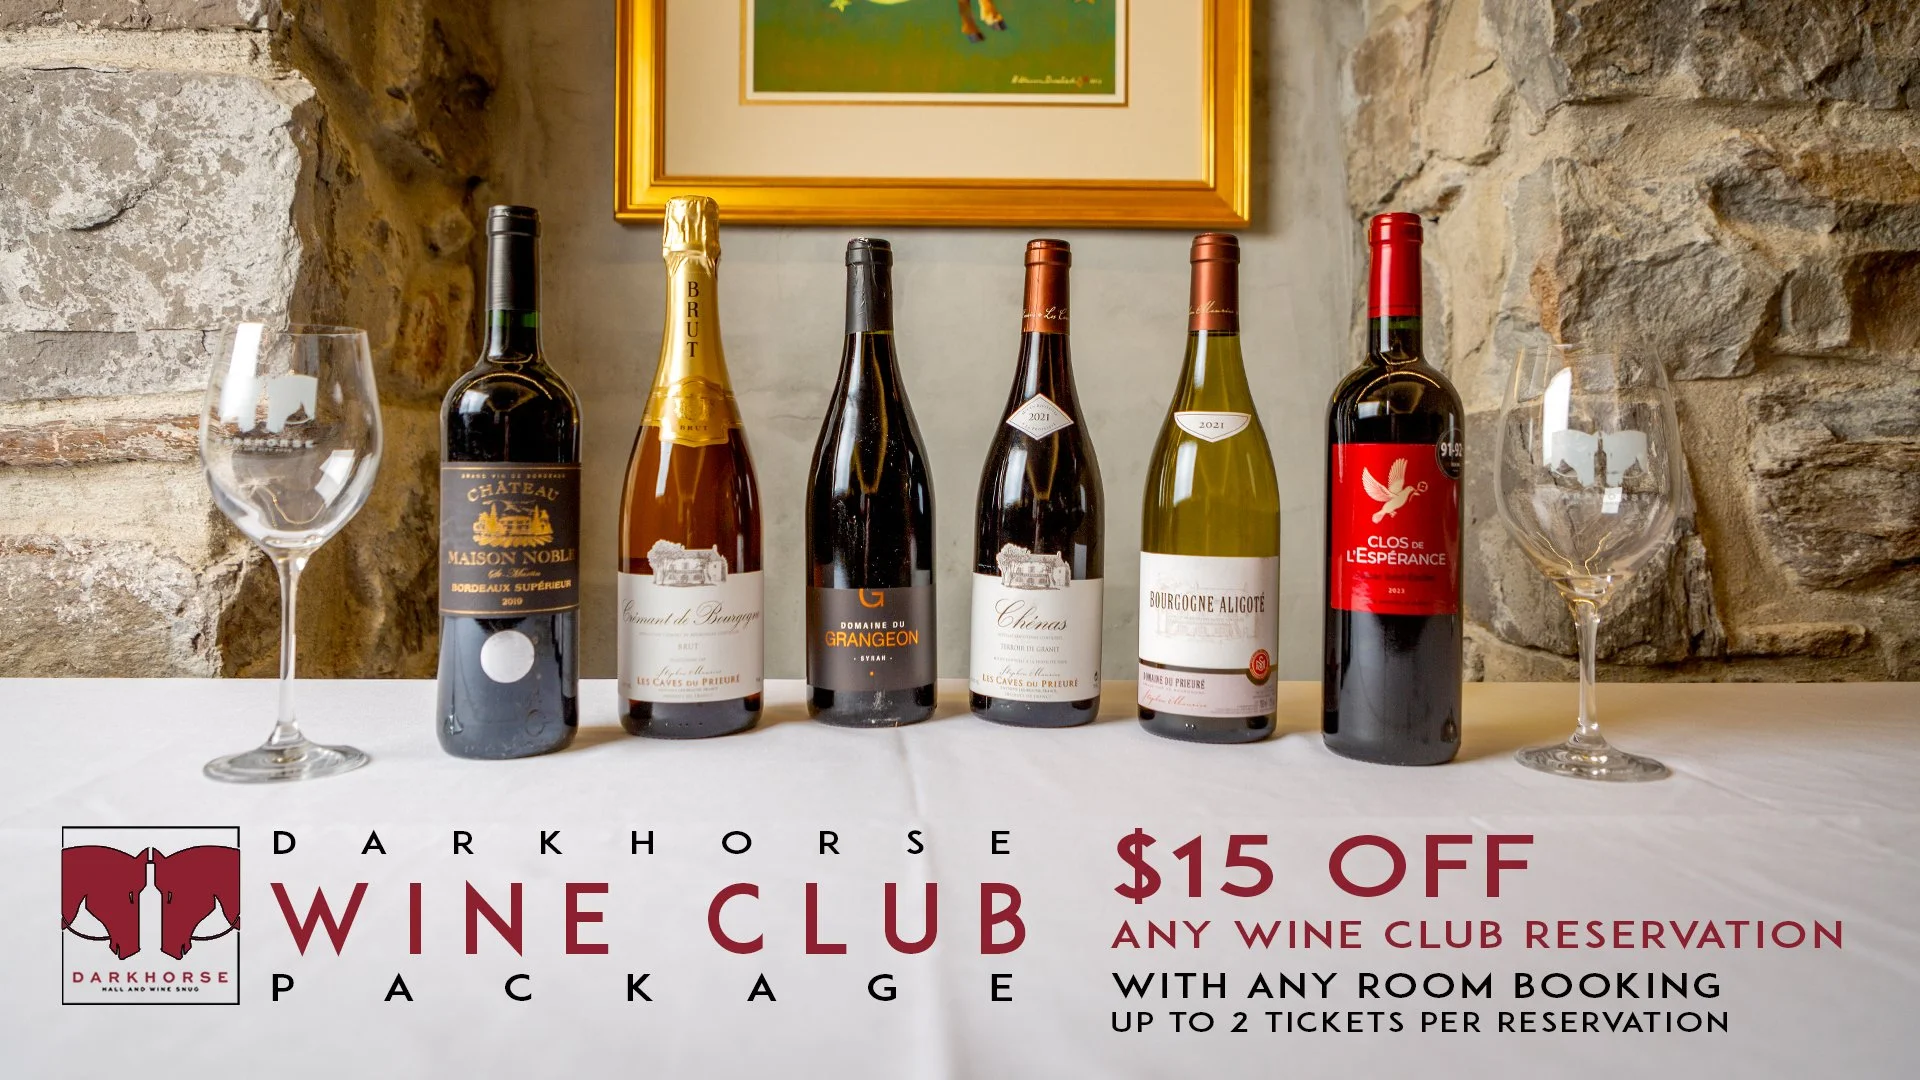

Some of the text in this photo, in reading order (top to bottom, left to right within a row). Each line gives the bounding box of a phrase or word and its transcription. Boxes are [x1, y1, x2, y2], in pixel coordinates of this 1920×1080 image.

[686, 281, 700, 358] BRUT
[1029, 412, 1050, 421] 2021
[1199, 421, 1225, 430] 2021
[467, 480, 560, 502] CHÂTEAU
[1367, 535, 1424, 550] CLOS DE
[448, 549, 575, 566] MAISON NOBLE
[1346, 547, 1446, 566] L'ESPÉRANCE
[452, 579, 572, 593] BORDEAUX SUPÉRIEUR
[858, 588, 885, 608] G
[1150, 590, 1265, 613] BOURGOGNE ALIGOTÉ
[622, 599, 674, 625] Crémant
[673, 608, 691, 626] de
[994, 598, 1068, 631] Chénas
[840, 620, 905, 630] DOMAINE DU
[825, 629, 919, 647] GRANGEON
[637, 676, 650, 686] LES
[653, 677, 682, 688] CAVES
[982, 673, 994, 683] LES
[996, 677, 1023, 687] CAVES
[1041, 677, 1078, 688] PRIEURÉ
